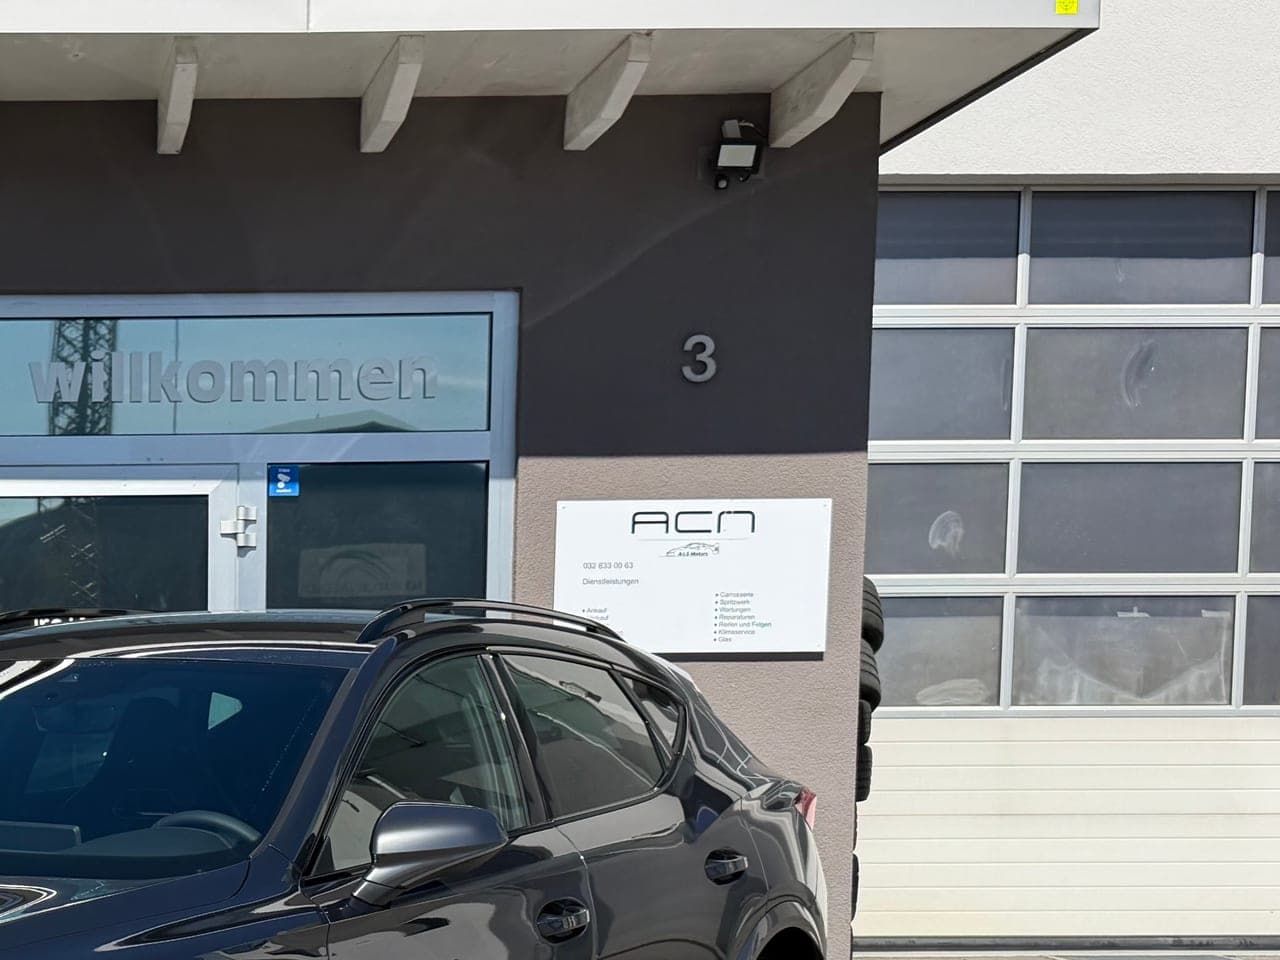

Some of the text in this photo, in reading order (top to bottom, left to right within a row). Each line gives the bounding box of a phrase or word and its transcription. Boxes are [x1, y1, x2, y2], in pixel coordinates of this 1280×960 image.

[681, 334, 718, 384] 3
[28, 351, 438, 405] willkommen
[631, 510, 755, 534] ACN
[582, 577, 640, 586] Dienstleistungen
